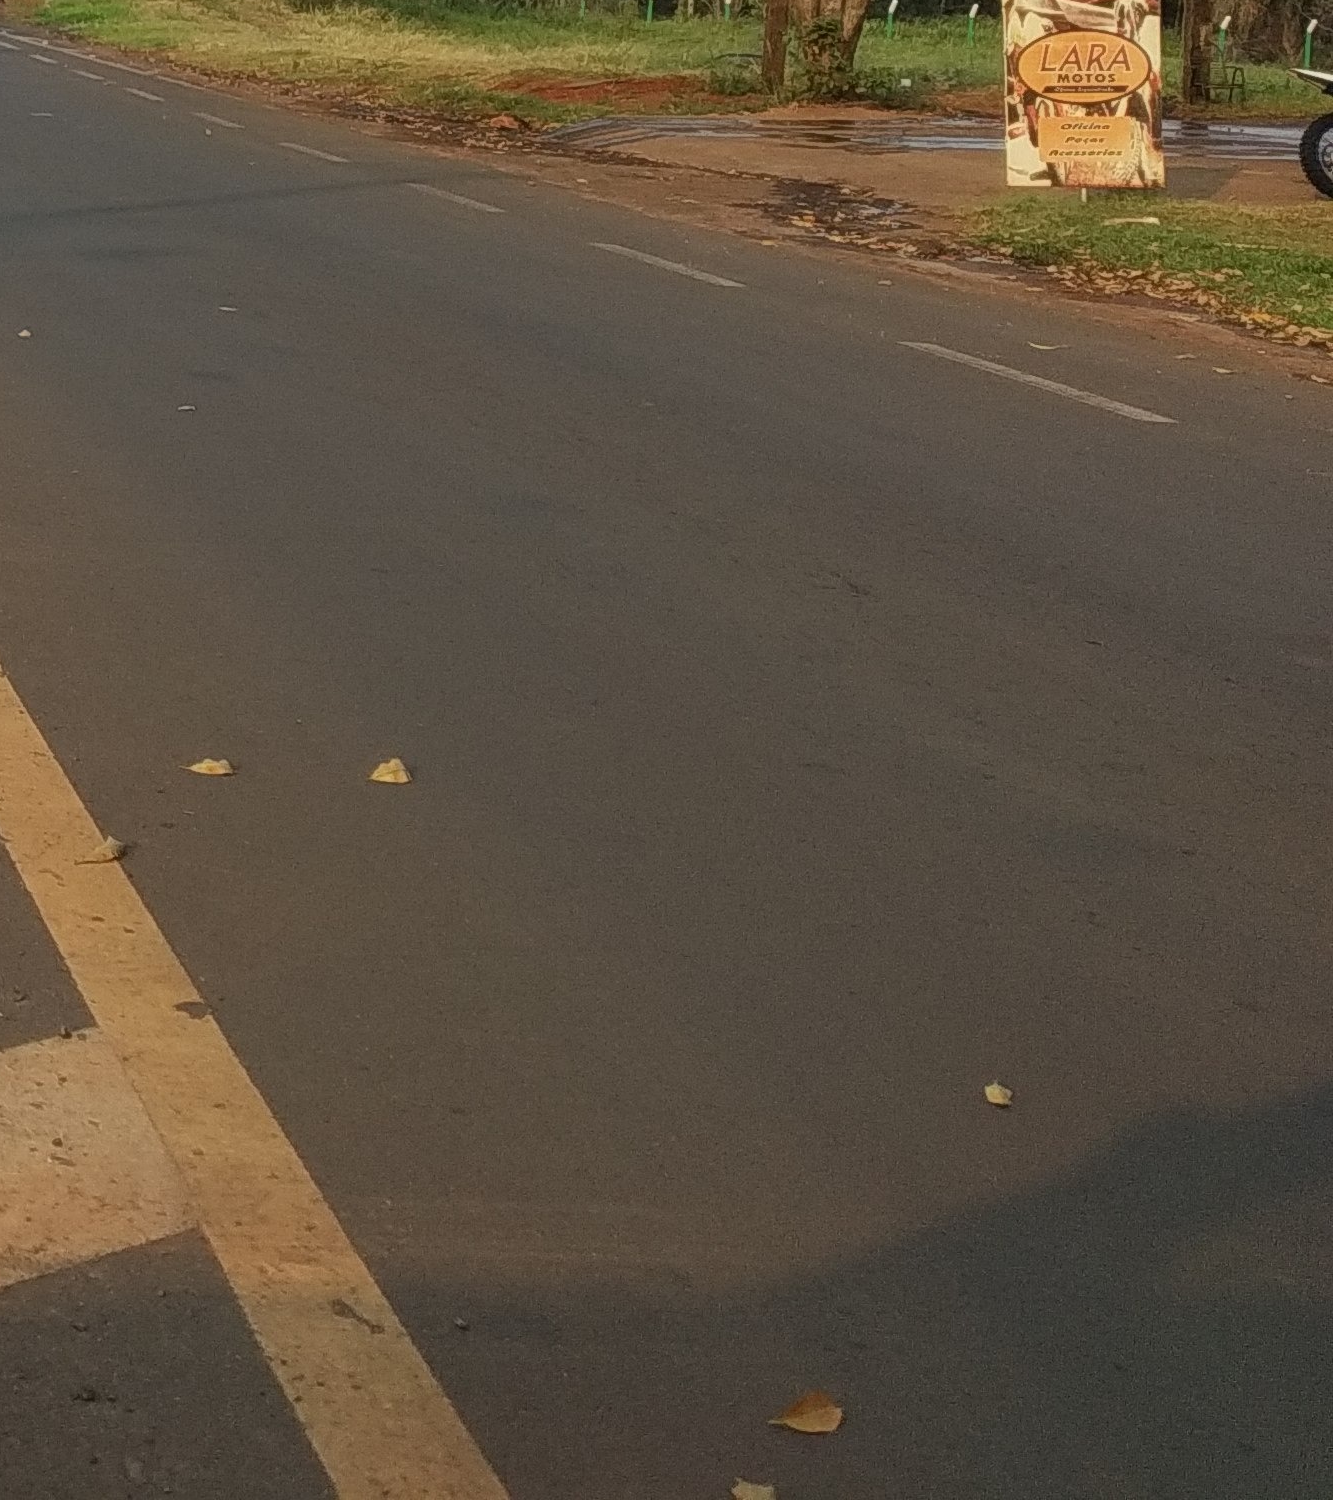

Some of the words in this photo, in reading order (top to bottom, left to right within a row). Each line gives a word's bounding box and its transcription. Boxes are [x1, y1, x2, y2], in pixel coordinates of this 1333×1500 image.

[1040, 43, 1131, 72] LARA
[1056, 73, 1116, 83] MOTOS
[1060, 122, 1111, 130] Oficina
